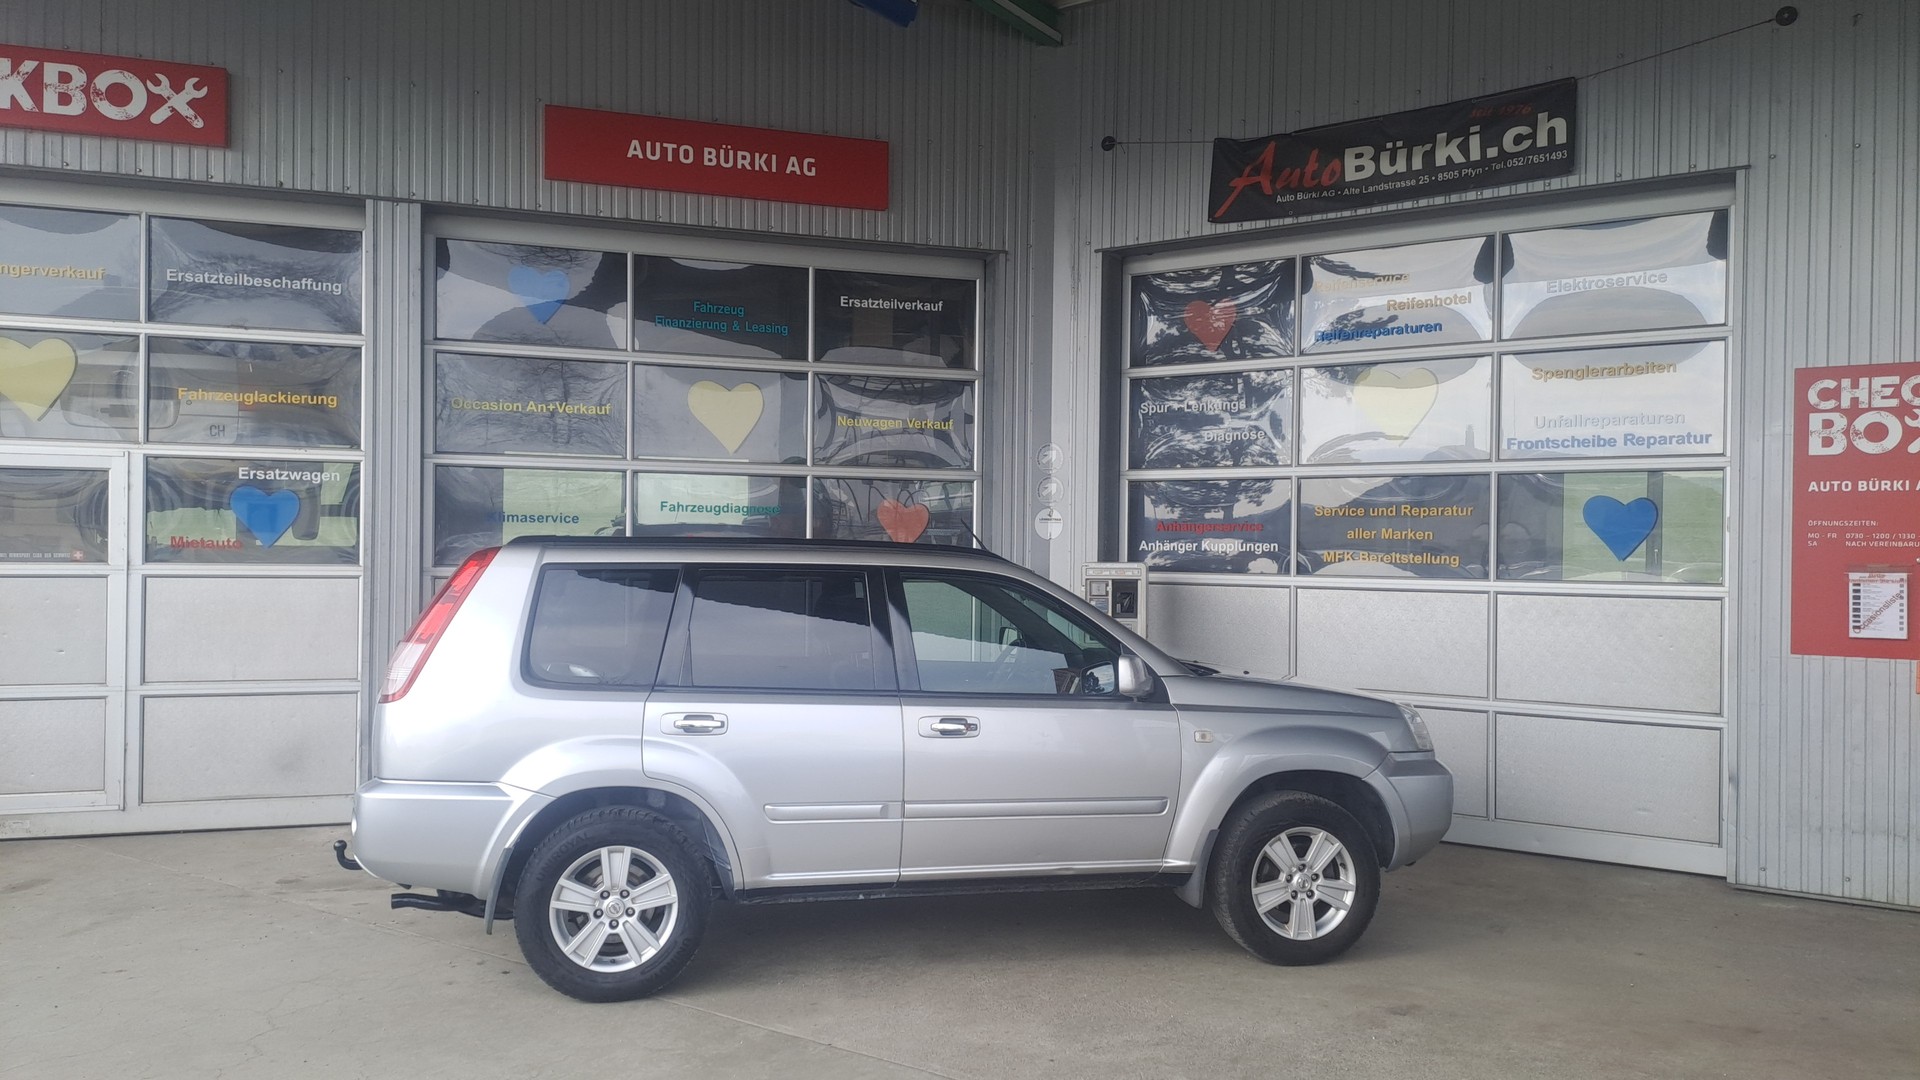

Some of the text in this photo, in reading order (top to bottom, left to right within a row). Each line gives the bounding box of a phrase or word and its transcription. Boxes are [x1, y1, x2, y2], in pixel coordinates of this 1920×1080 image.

[627, 139, 817, 177] AUTO BÜRKI AG
[1276, 194, 1295, 203] Auto
[1321, 189, 1336, 198] AG
[1343, 187, 1360, 196] Alte
[1362, 179, 1416, 193] Landstrasse
[1418, 175, 1430, 185] 25
[1437, 170, 1459, 182] 8505
[1462, 166, 1483, 178] Pfyn
[165, 268, 343, 296] Ersatzteilbeschaffung
[1546, 271, 1668, 294] Elektroservice
[693, 300, 745, 318] Fahrzeug
[840, 295, 944, 312] Ersatzteilverkauf
[1386, 291, 1472, 311] Reifenhotel
[655, 315, 790, 336] Finanzierung & Leasing
[1315, 321, 1443, 342] Reifenreparaturen
[1532, 361, 1677, 383] Spenglerarbeiten
[177, 387, 339, 409] Fahrzeuglackierung
[451, 397, 522, 412] Occasion
[1140, 401, 1169, 415] Spur
[1184, 399, 1247, 414] Lenkungs
[837, 415, 955, 432] Neuwagen Verkauf
[1534, 411, 1686, 430] Unfallreparaturen
[1204, 428, 1266, 444] Diagnose
[1506, 432, 1712, 451] Frontscheibe Reparatur
[238, 467, 341, 485] Ersatzwagen
[1808, 480, 1852, 492] AUTO
[1858, 478, 1910, 492] BÜRKI
[660, 500, 780, 517] Fahrzeugdiagnose
[1314, 504, 1473, 519] Service und Reparatur
[1155, 520, 1264, 535] Anhängerservice
[1347, 527, 1434, 540] aller Marken
[170, 535, 244, 550] Mietauto
[1139, 539, 1279, 554] Anhänger Kupplungen
